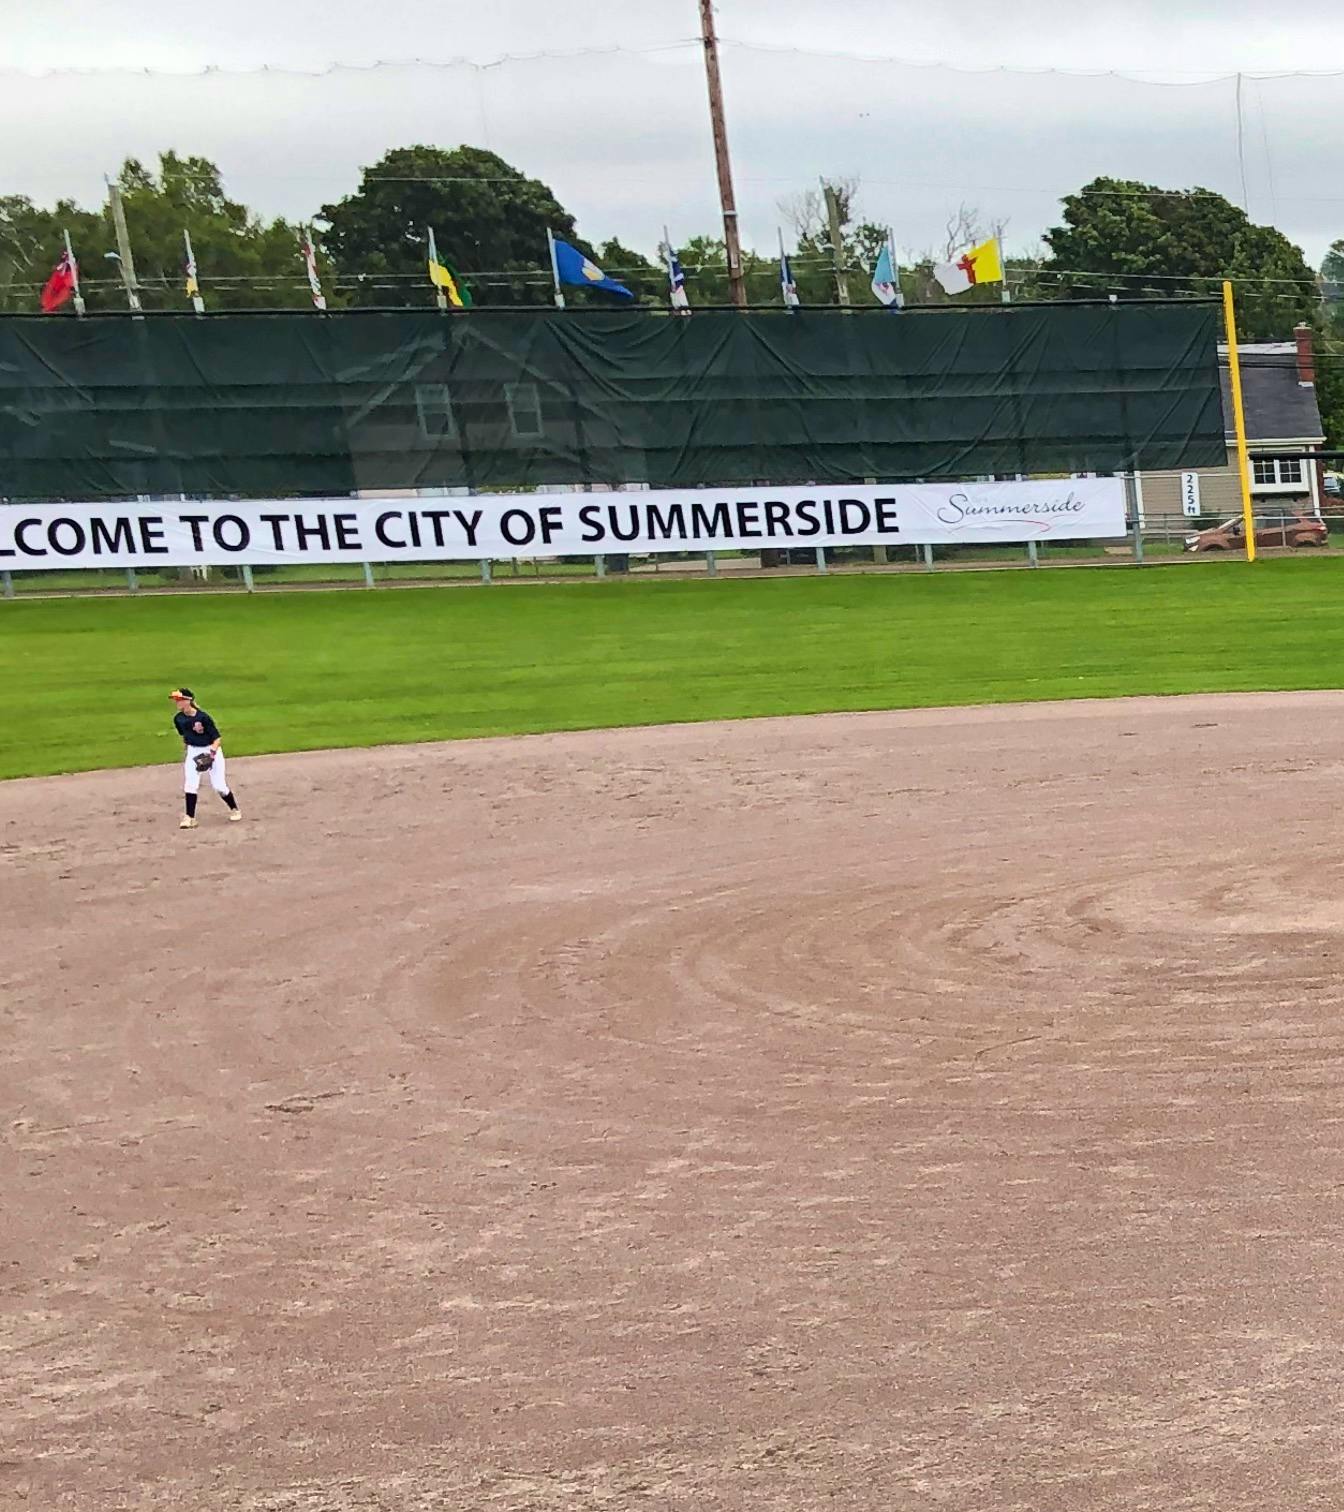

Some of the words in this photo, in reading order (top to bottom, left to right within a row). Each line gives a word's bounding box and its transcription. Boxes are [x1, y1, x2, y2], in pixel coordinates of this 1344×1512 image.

[0, 516, 169, 556] COME
[179, 514, 250, 552] TO
[260, 513, 363, 551] THE
[375, 510, 483, 548] CITY
[500, 507, 563, 546] OF
[578, 498, 900, 542] SUMMERSIDE
[937, 491, 1086, 524] Summerside
